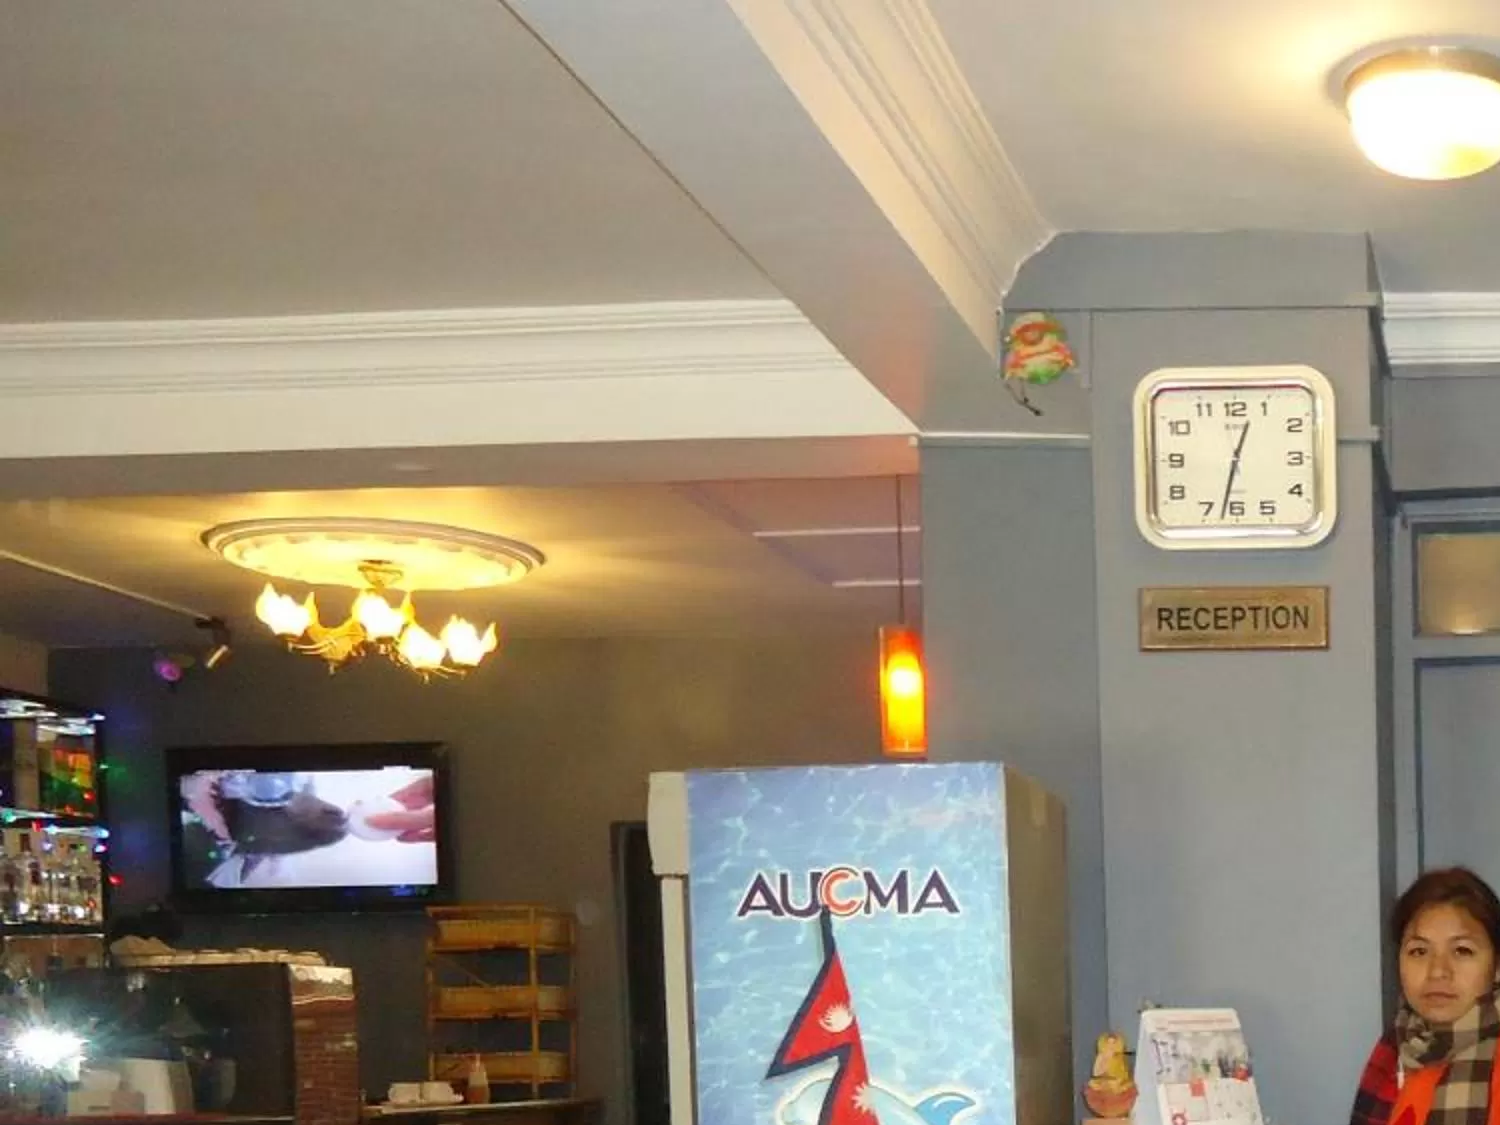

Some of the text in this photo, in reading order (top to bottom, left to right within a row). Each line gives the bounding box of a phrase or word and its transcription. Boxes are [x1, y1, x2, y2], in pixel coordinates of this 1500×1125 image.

[1196, 402, 1212, 417] 11
[1224, 401, 1247, 417] 12
[1260, 401, 1268, 417] 1
[1168, 420, 1191, 435] 10
[1287, 418, 1304, 433] 2
[1168, 453, 1185, 468] 9
[1287, 451, 1304, 466] 3
[1169, 485, 1186, 500] 8
[1287, 483, 1304, 498] 4
[1198, 501, 1215, 516] 7
[1229, 501, 1246, 516] 6
[1259, 500, 1276, 515] 5
[1156, 605, 1310, 631] RECEPTION
[736, 866, 961, 918] AUCMA
